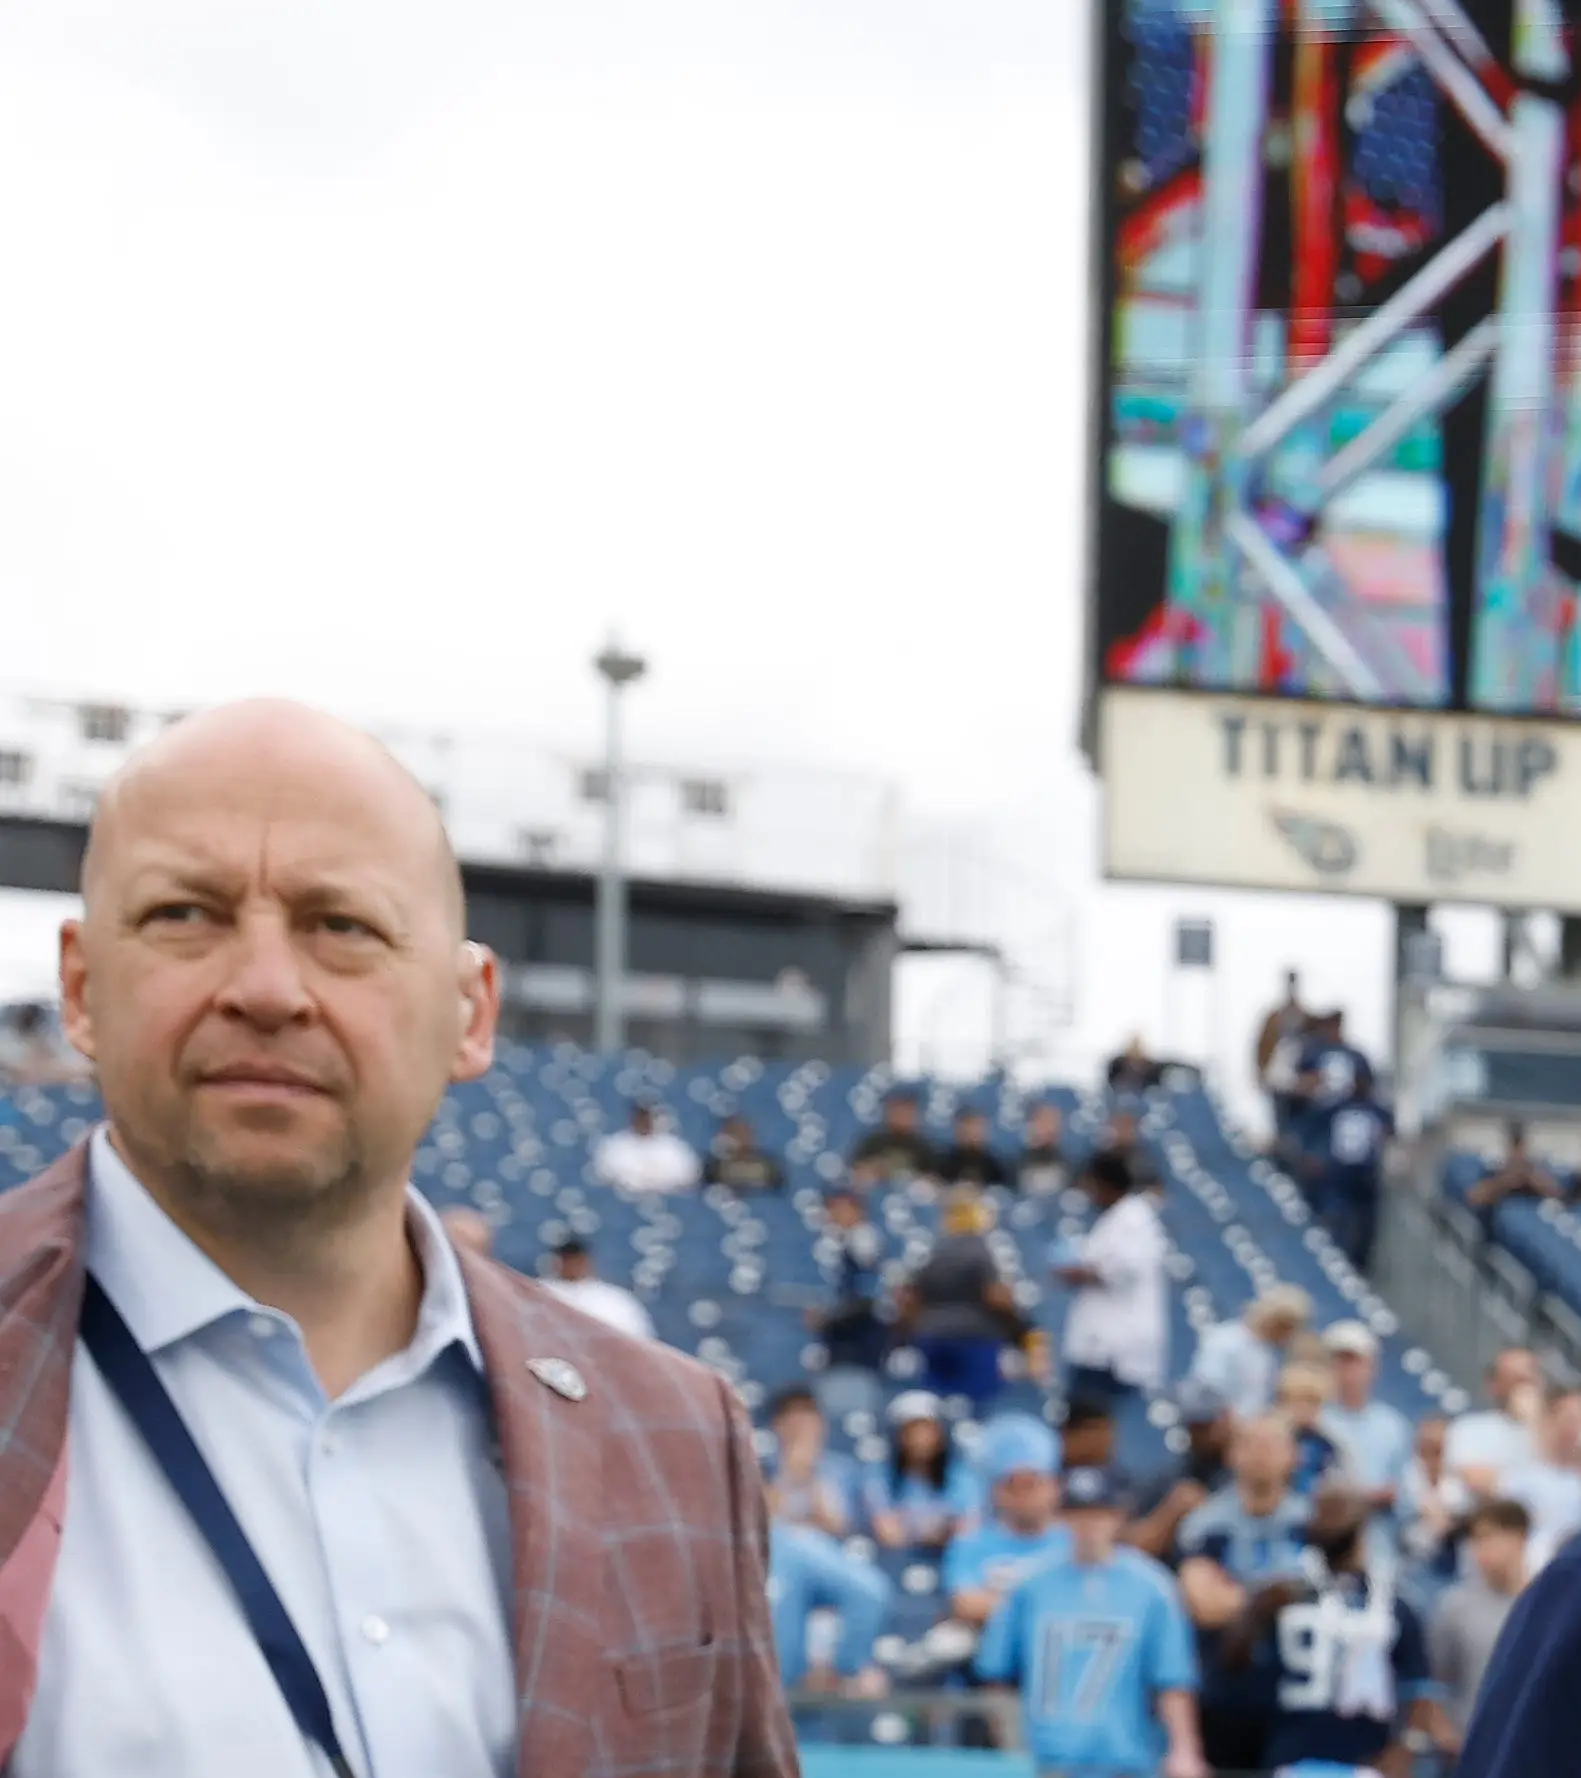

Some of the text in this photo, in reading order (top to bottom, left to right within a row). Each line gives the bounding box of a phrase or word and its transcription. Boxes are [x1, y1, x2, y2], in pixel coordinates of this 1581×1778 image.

[1216, 711, 1559, 798] TITAN UP
[1035, 1616, 1135, 1719] 17
